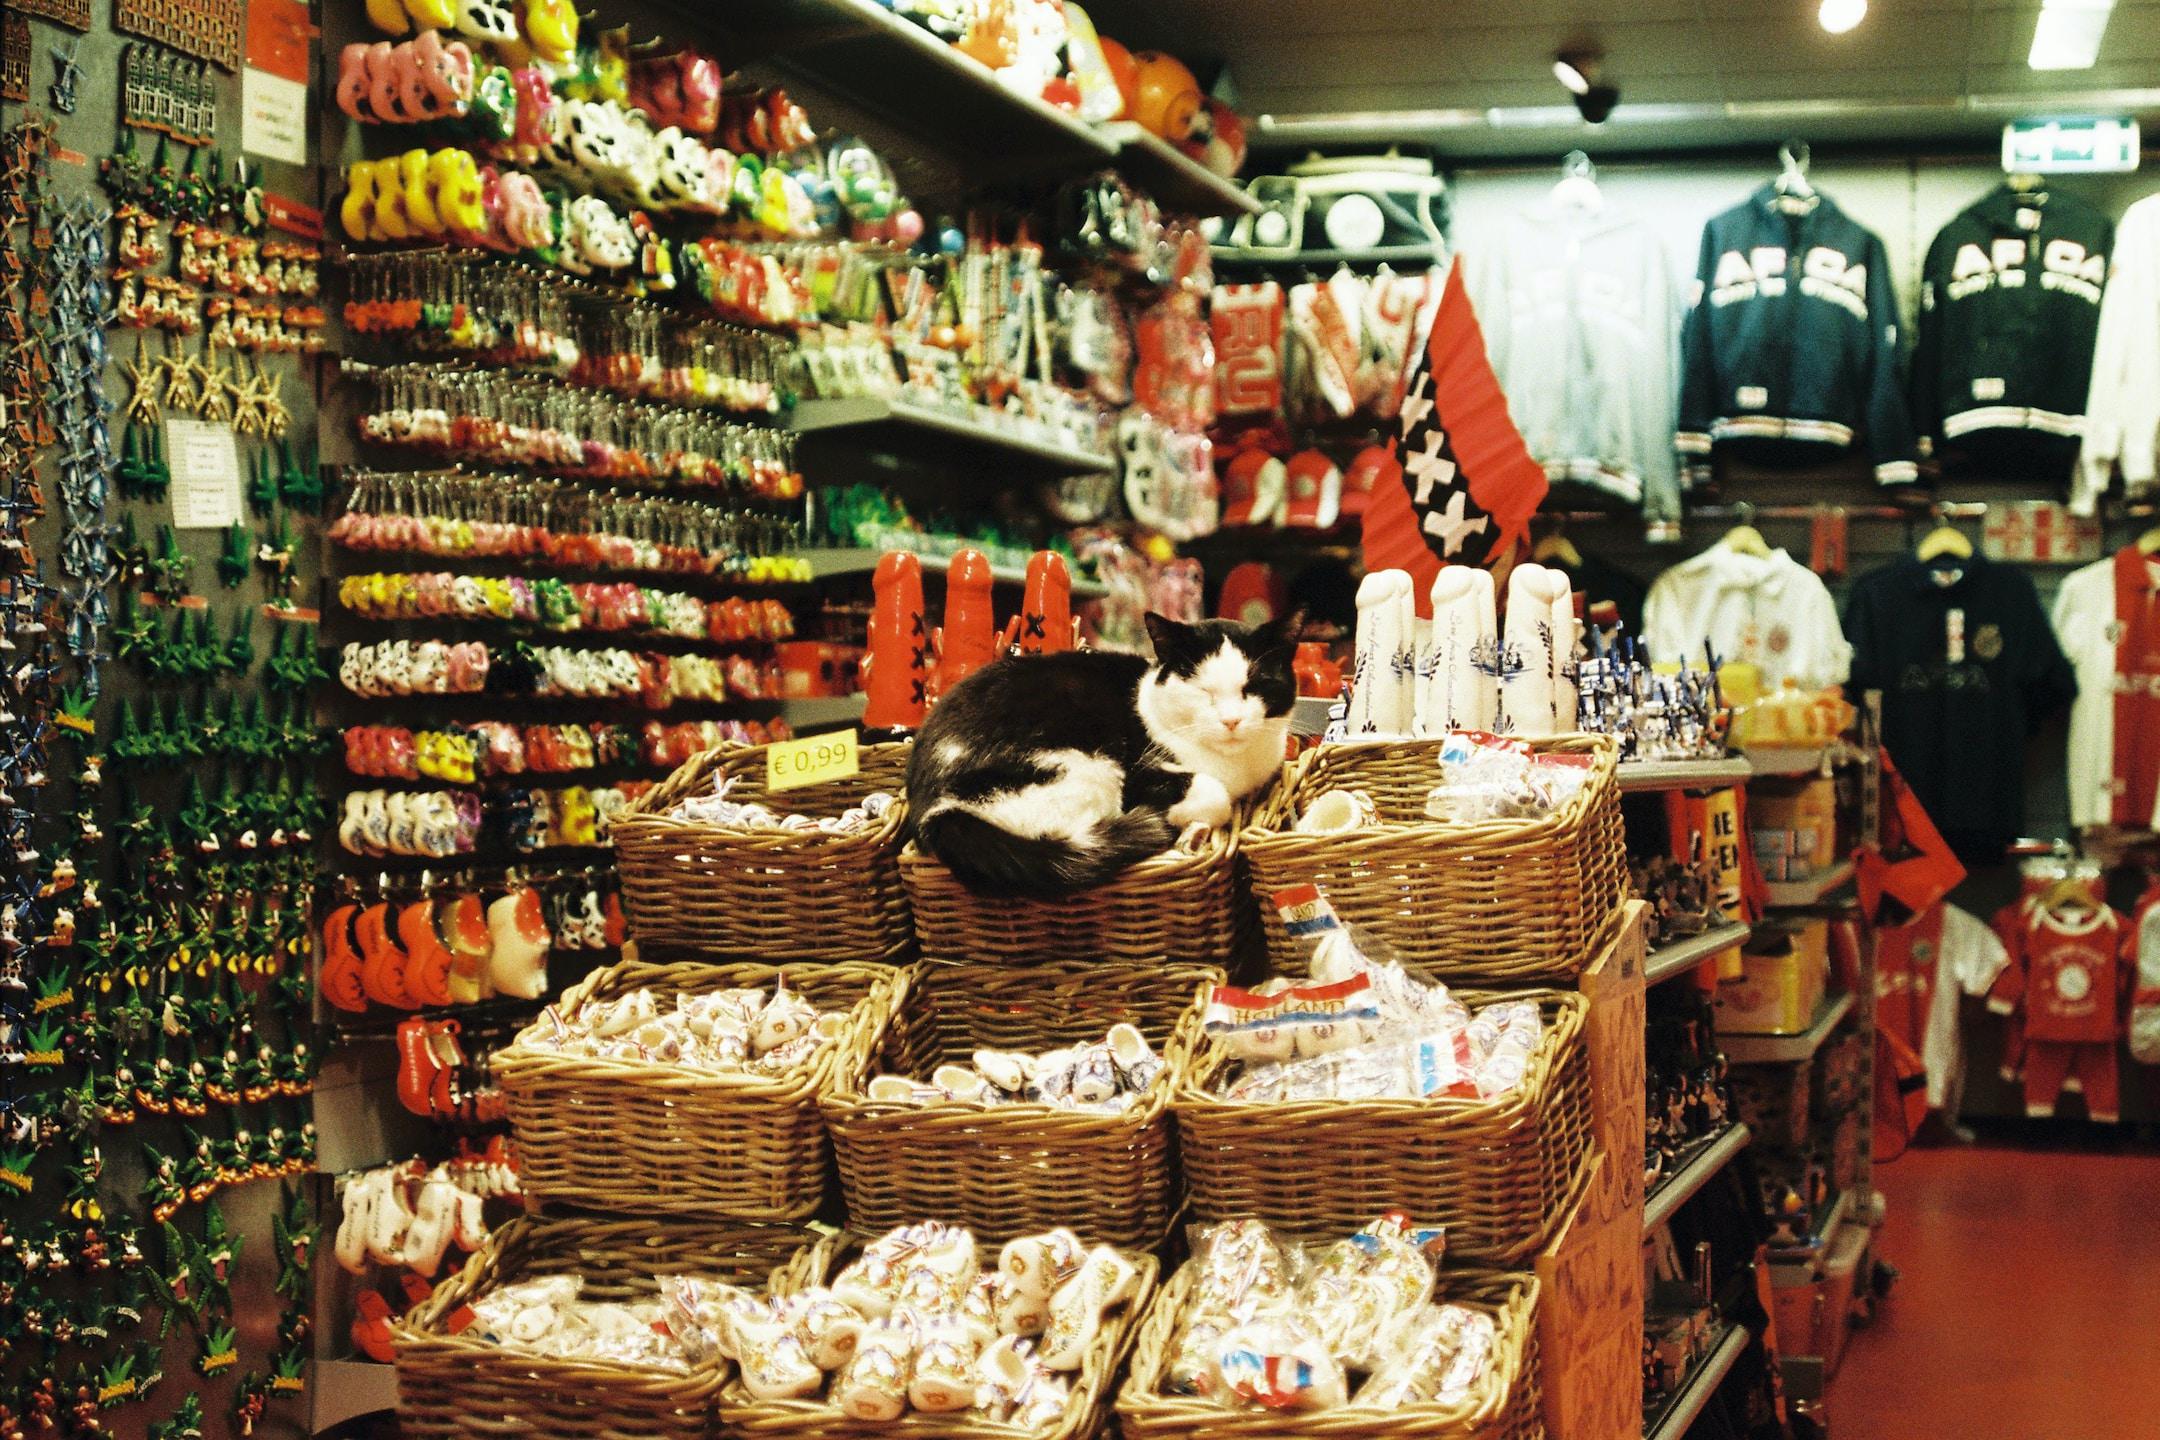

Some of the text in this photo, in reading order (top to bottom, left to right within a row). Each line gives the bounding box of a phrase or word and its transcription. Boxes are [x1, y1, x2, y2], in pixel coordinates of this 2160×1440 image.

[774, 743, 847, 775] € 0,99
[1236, 999, 1346, 1023] HOLLAND
